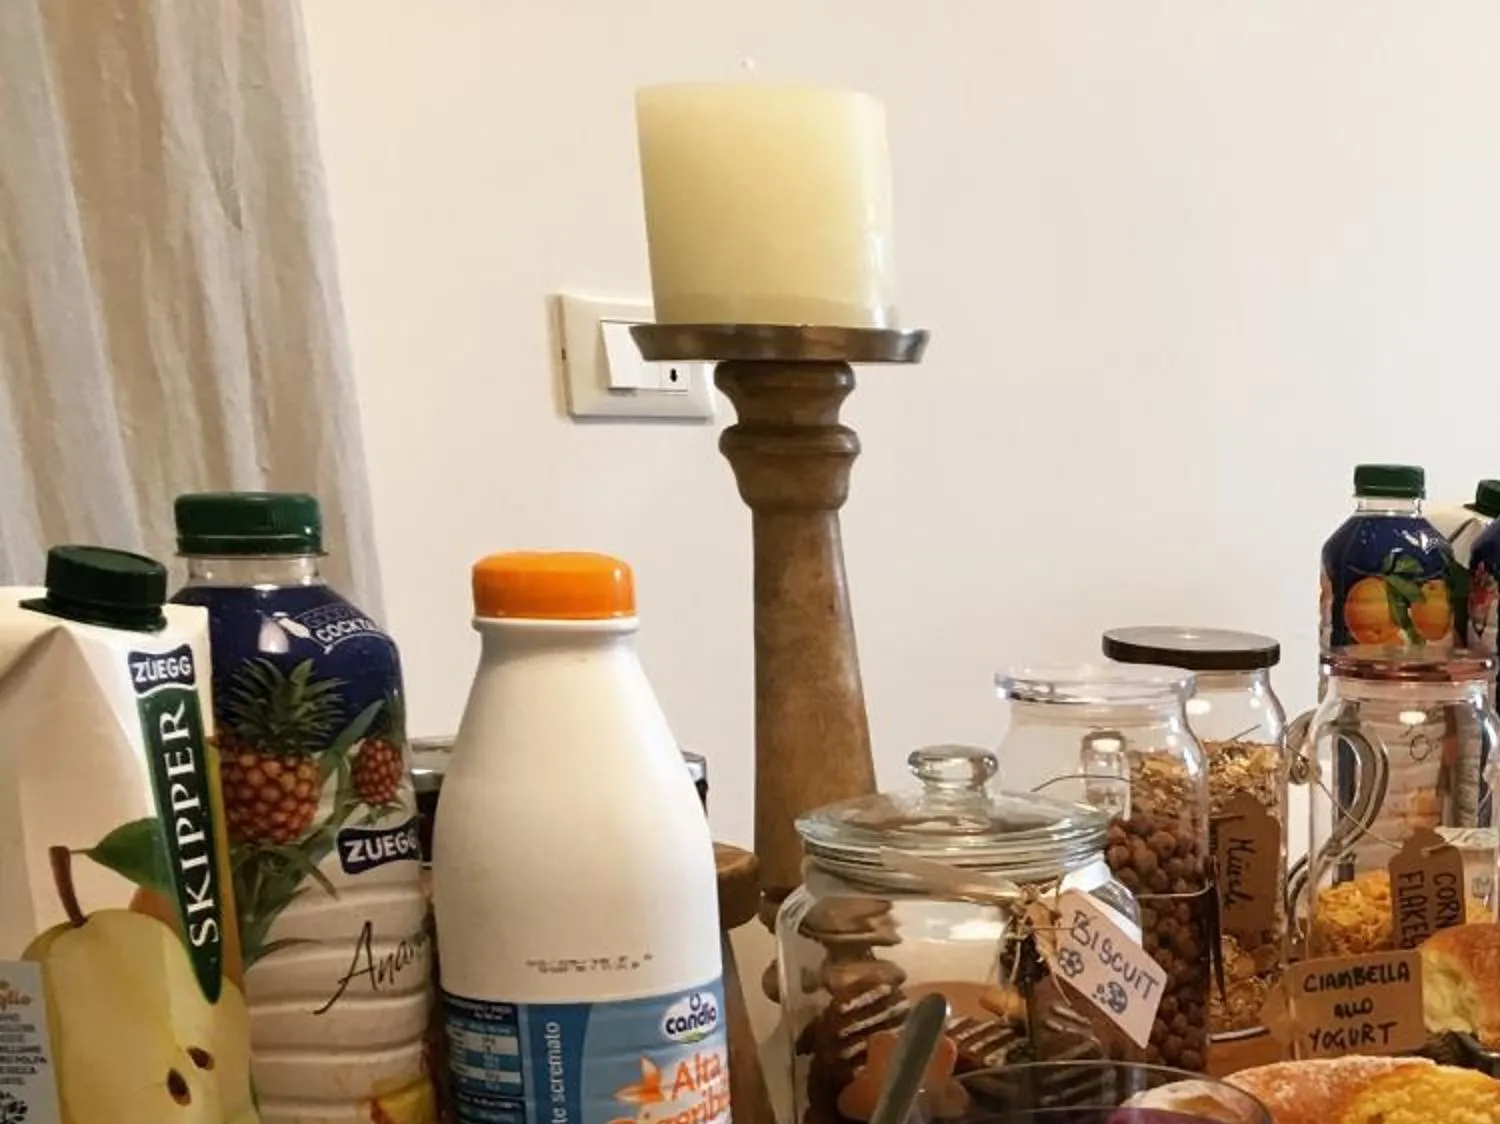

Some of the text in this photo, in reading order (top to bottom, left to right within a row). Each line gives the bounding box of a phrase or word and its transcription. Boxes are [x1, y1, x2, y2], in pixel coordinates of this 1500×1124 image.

[132, 656, 193, 683] ZUEGG
[160, 702, 219, 948] SKIPPER
[1432, 868, 1460, 929] CORN
[1070, 910, 1160, 1001] BISCUIT
[1303, 961, 1411, 993] CIAMBELLA
[665, 1002, 717, 1035] candia
[1333, 997, 1374, 1019] ALLO
[1308, 1021, 1399, 1052] YOGURT
